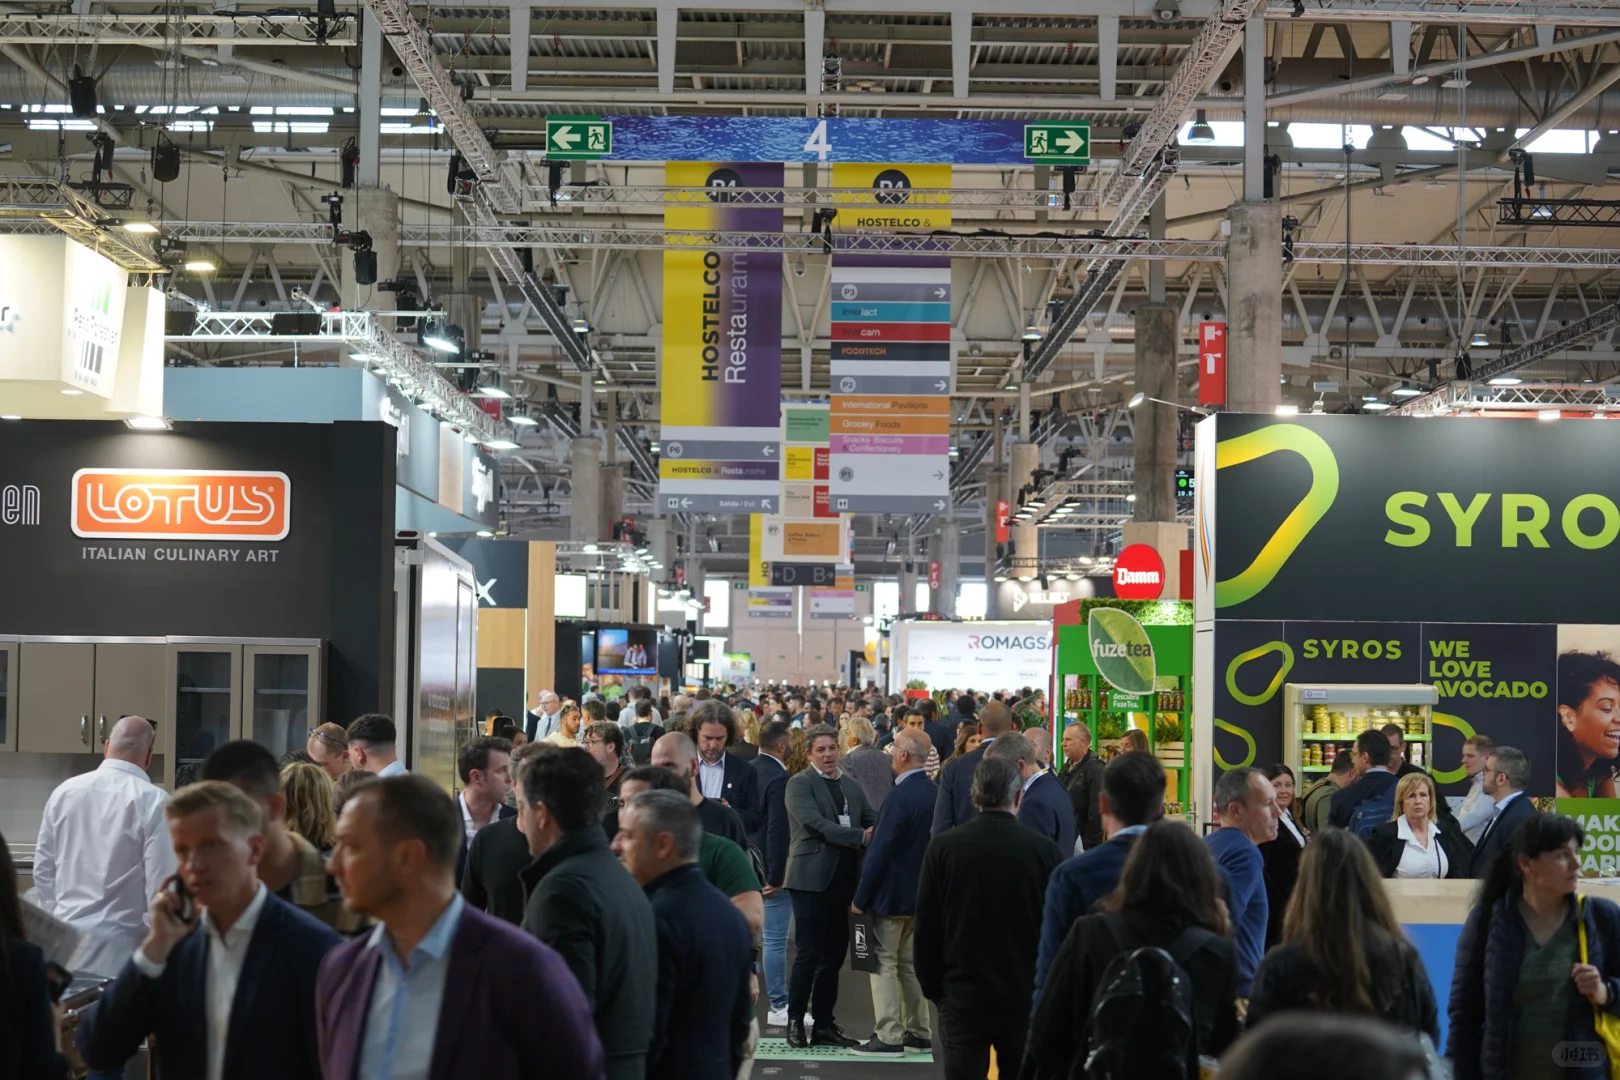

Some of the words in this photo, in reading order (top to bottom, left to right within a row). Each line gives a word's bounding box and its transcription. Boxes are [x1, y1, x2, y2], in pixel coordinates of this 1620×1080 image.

[804, 120, 832, 160] 4
[857, 218, 920, 227] HOSTELCO
[923, 218, 931, 227] &
[844, 288, 855, 296] P3
[702, 251, 720, 381] HOSTELCO
[841, 347, 887, 355] FOODTECH
[842, 381, 853, 389] P2
[842, 401, 890, 409] International
[892, 401, 928, 409] Pavilions
[842, 420, 874, 429] Grocery
[876, 420, 901, 428] Foods
[874, 436, 904, 444] Biscuits
[669, 446, 680, 454] P6
[849, 444, 902, 454] Confectionery
[1384, 491, 1620, 550] SYRO
[82, 547, 146, 561] ITALIAN
[153, 548, 241, 562] CULINARY
[245, 549, 279, 563] ART
[783, 567, 796, 582] D
[813, 567, 826, 583] B
[1117, 568, 1160, 585] Damm
[1092, 639, 1151, 659] fuzetea
[1303, 639, 1402, 660] SYROS
[1429, 640, 1470, 658] WE
[1429, 660, 1491, 678] LOVE
